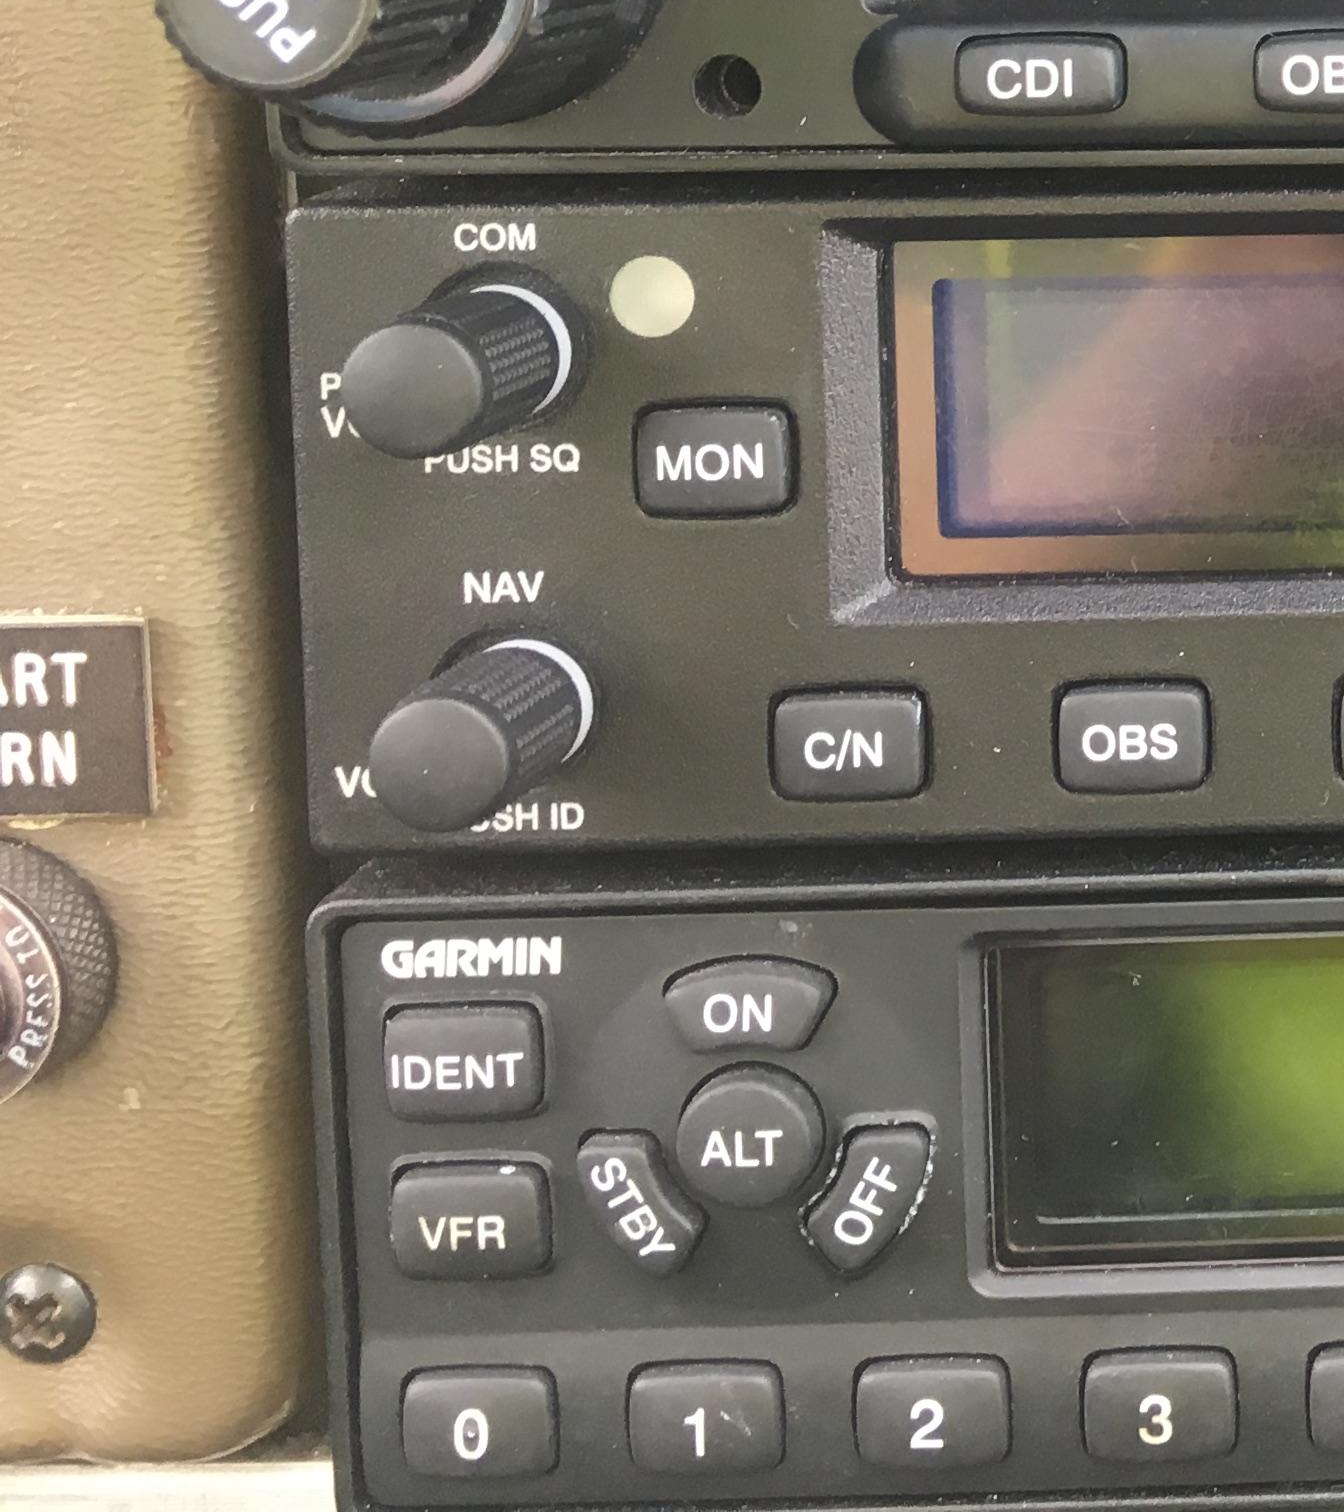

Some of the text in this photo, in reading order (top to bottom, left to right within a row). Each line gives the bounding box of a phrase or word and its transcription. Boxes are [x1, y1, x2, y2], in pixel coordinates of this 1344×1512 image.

[986, 58, 1073, 100] CDI
[453, 222, 537, 252] COM
[425, 443, 579, 472] PUSH SQ
[656, 442, 764, 482] MON
[463, 570, 545, 604] NAV
[804, 728, 883, 772] C/N
[1081, 722, 1178, 762] OBS
[550, 802, 585, 830] ID
[380, 936, 562, 979] GARMIN
[702, 993, 773, 1034] ON
[390, 1051, 524, 1091] IDENT
[700, 1129, 784, 1168] ALT
[591, 1157, 676, 1260] STBY
[833, 1158, 900, 1247] OFF
[418, 1214, 506, 1251] VFR
[453, 1407, 489, 1460] 0
[684, 1407, 705, 1457] 1
[910, 1398, 944, 1449] 2
[1138, 1393, 1173, 1445] 3
